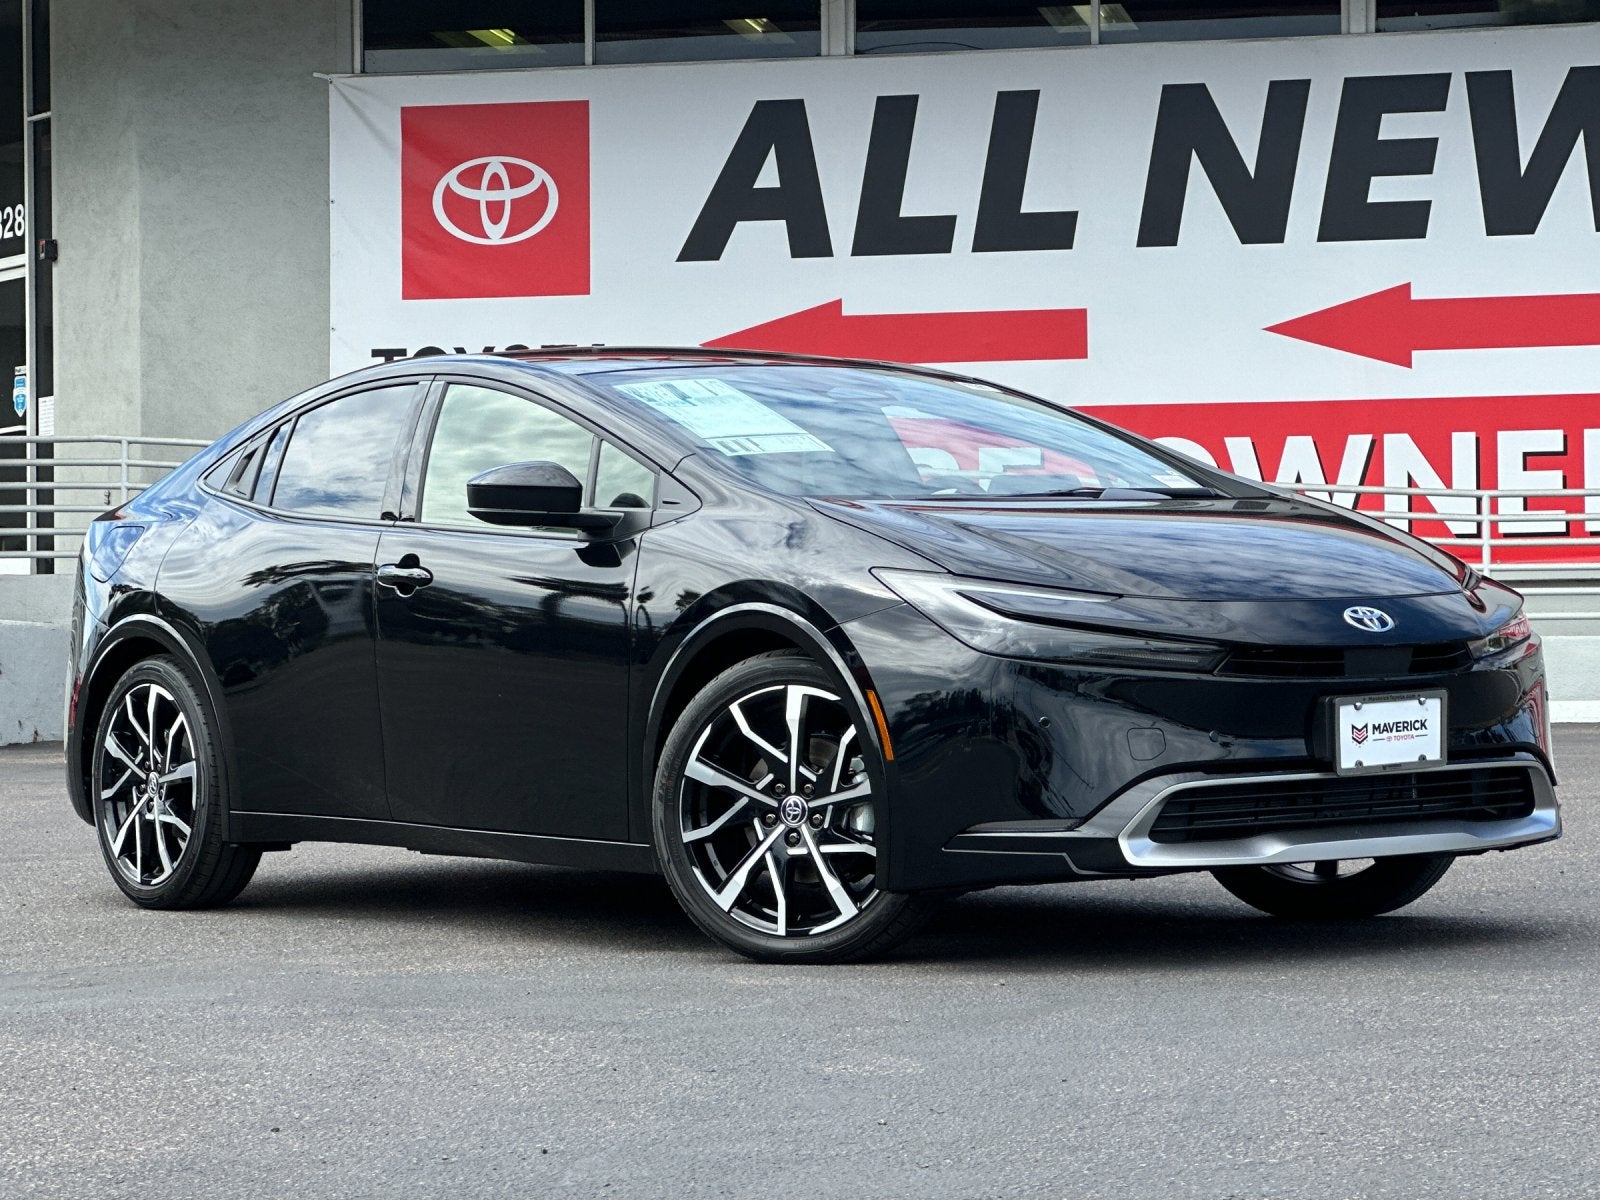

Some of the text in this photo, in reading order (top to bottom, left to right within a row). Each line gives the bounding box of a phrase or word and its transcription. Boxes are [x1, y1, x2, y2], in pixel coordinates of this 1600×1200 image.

[675, 89, 1079, 262] ALL
[0, 203, 25, 239] 28
[1372, 719, 1427, 734] MAVERICK
